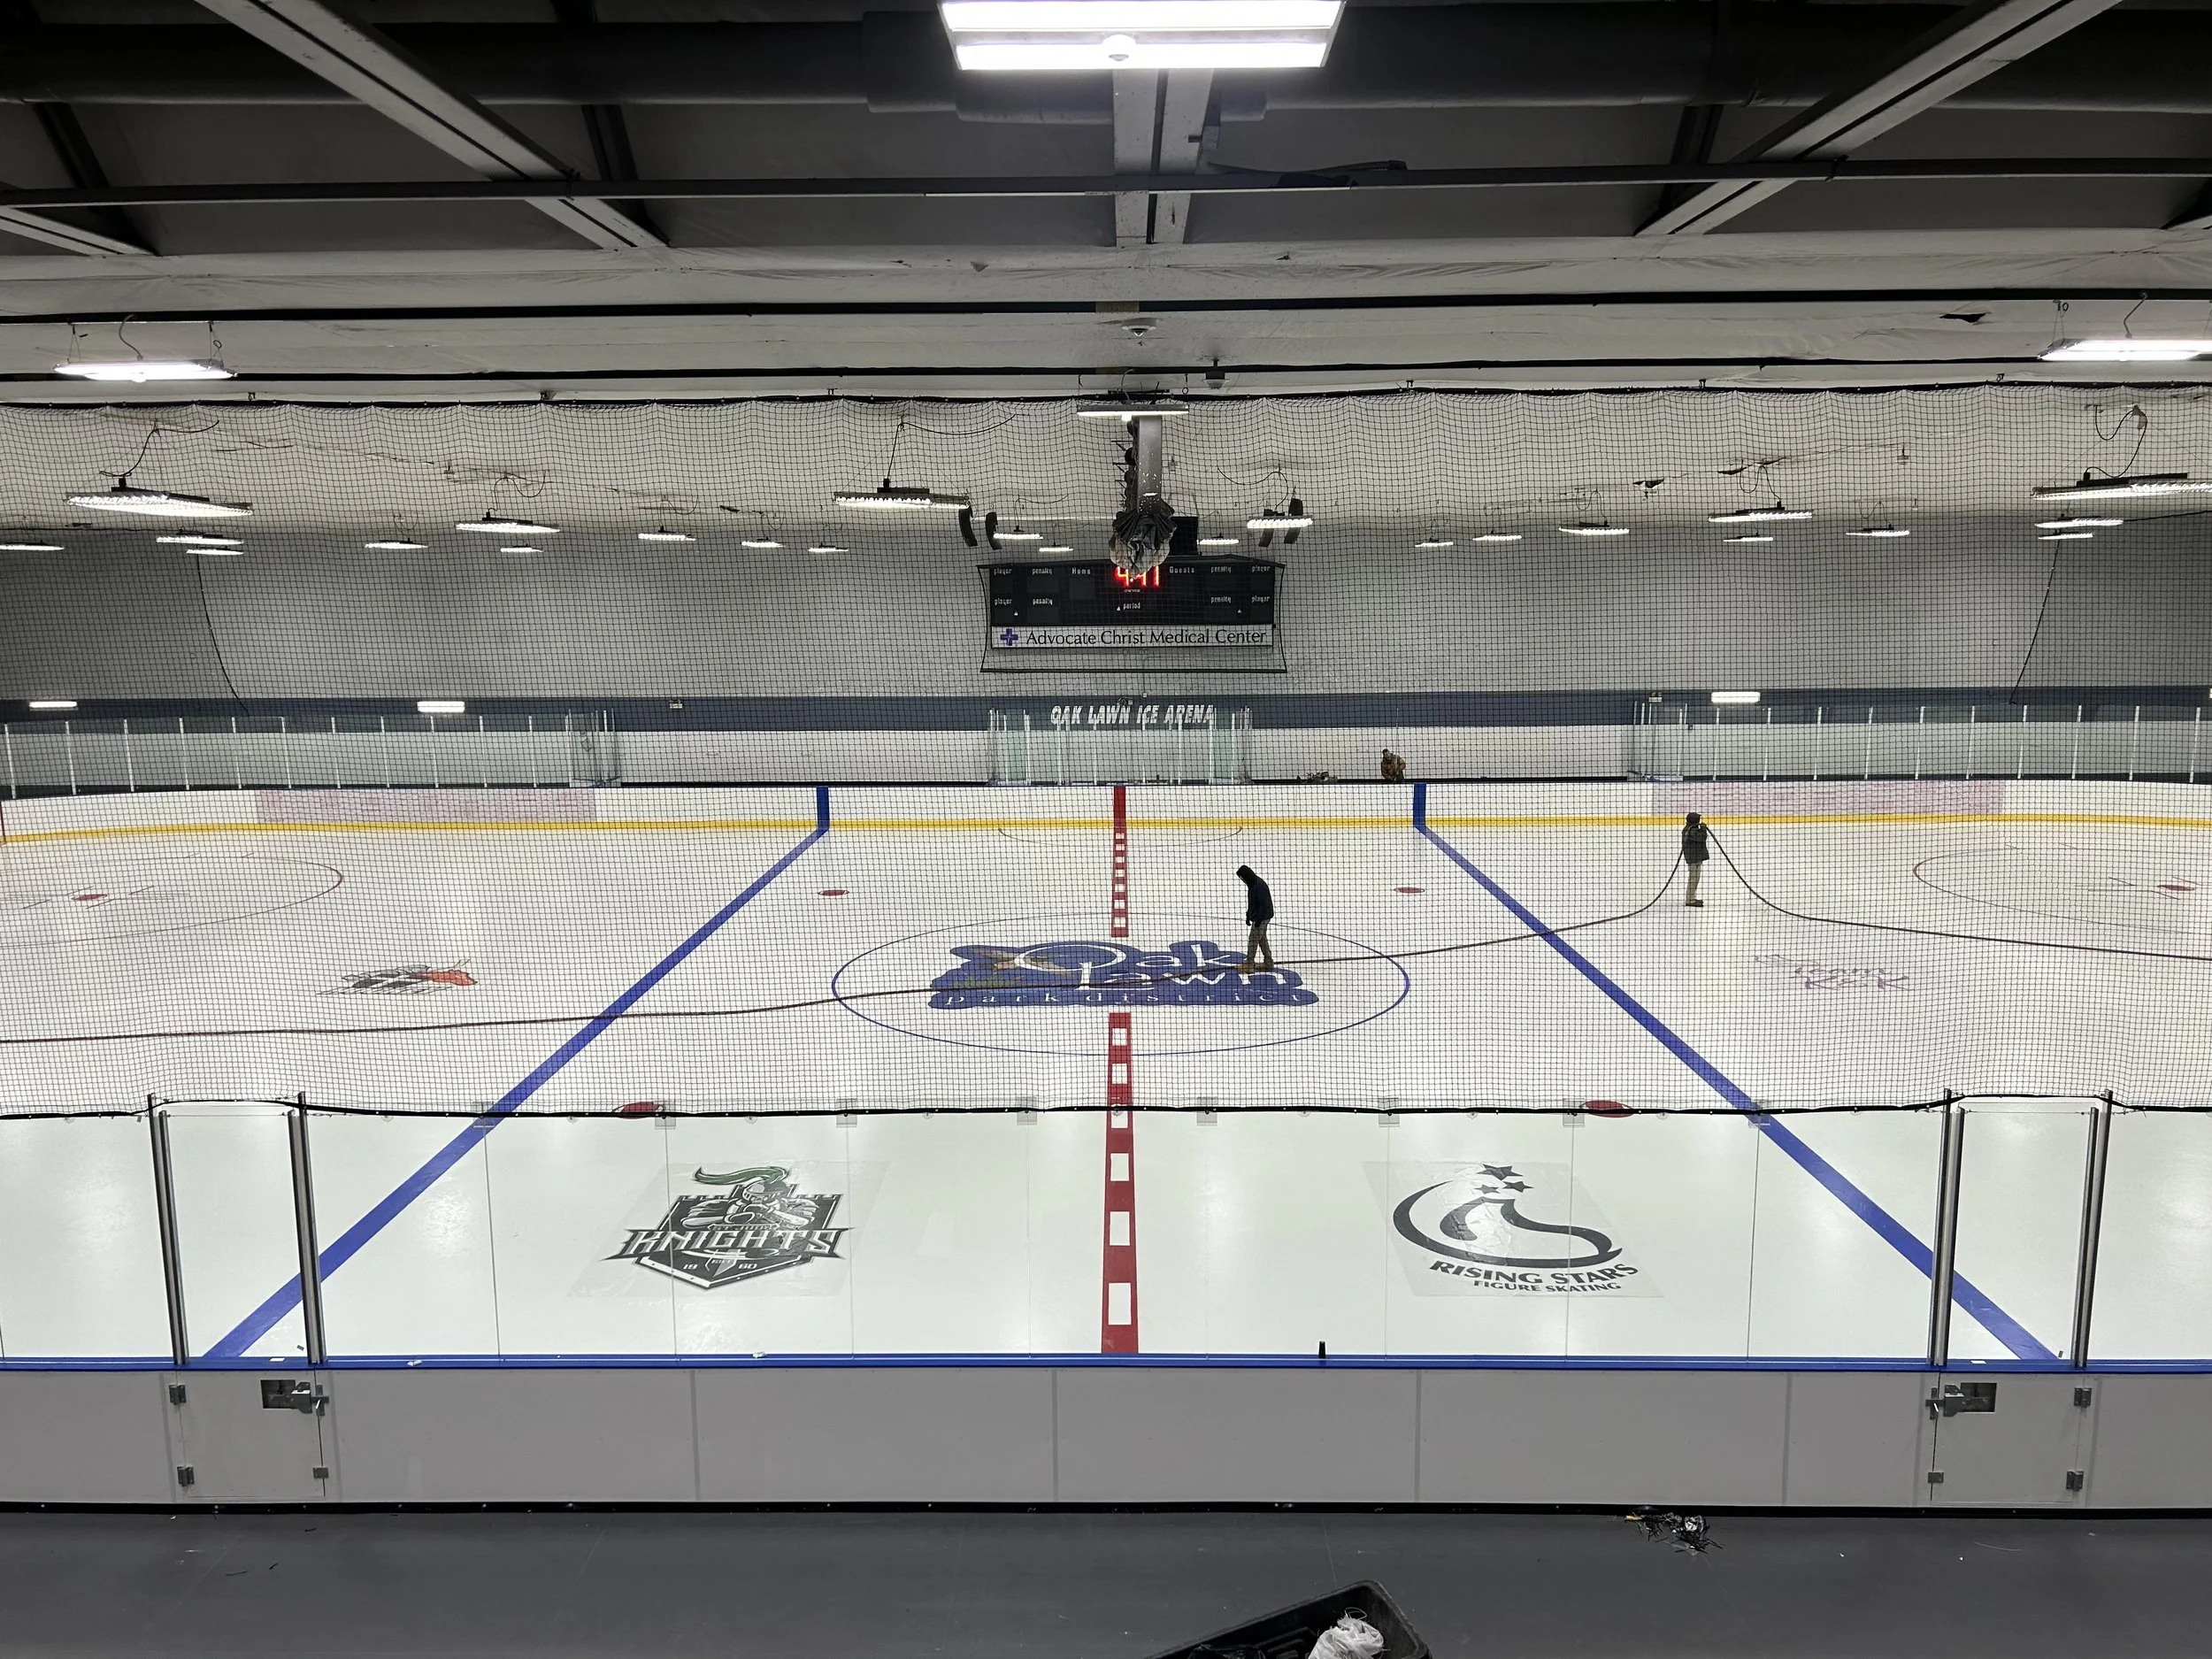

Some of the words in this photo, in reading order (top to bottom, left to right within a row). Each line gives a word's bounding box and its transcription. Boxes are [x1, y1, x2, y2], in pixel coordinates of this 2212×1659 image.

[1123, 602, 1141, 611] period
[1025, 630, 1097, 645] Advocate
[1100, 629, 1145, 645] Christ
[1149, 628, 1210, 644] Medical
[1215, 628, 1266, 643] Center
[1050, 704, 1083, 726] OAK
[1087, 704, 1130, 726] LAWN
[1136, 704, 1160, 725] ICE
[1163, 703, 1214, 725] ARENA
[1014, 943, 1239, 972] Oak
[1073, 962, 1287, 991] Lawn
[944, 992, 1060, 1006] park
[1085, 992, 1302, 1002] district
[626, 1229, 840, 1255] KNIGHTS
[1429, 1260, 1544, 1284] RISING
[1550, 1263, 1639, 1284] STARS
[1473, 1279, 1541, 1293] FIGURE
[1546, 1282, 1622, 1293] SKATING
